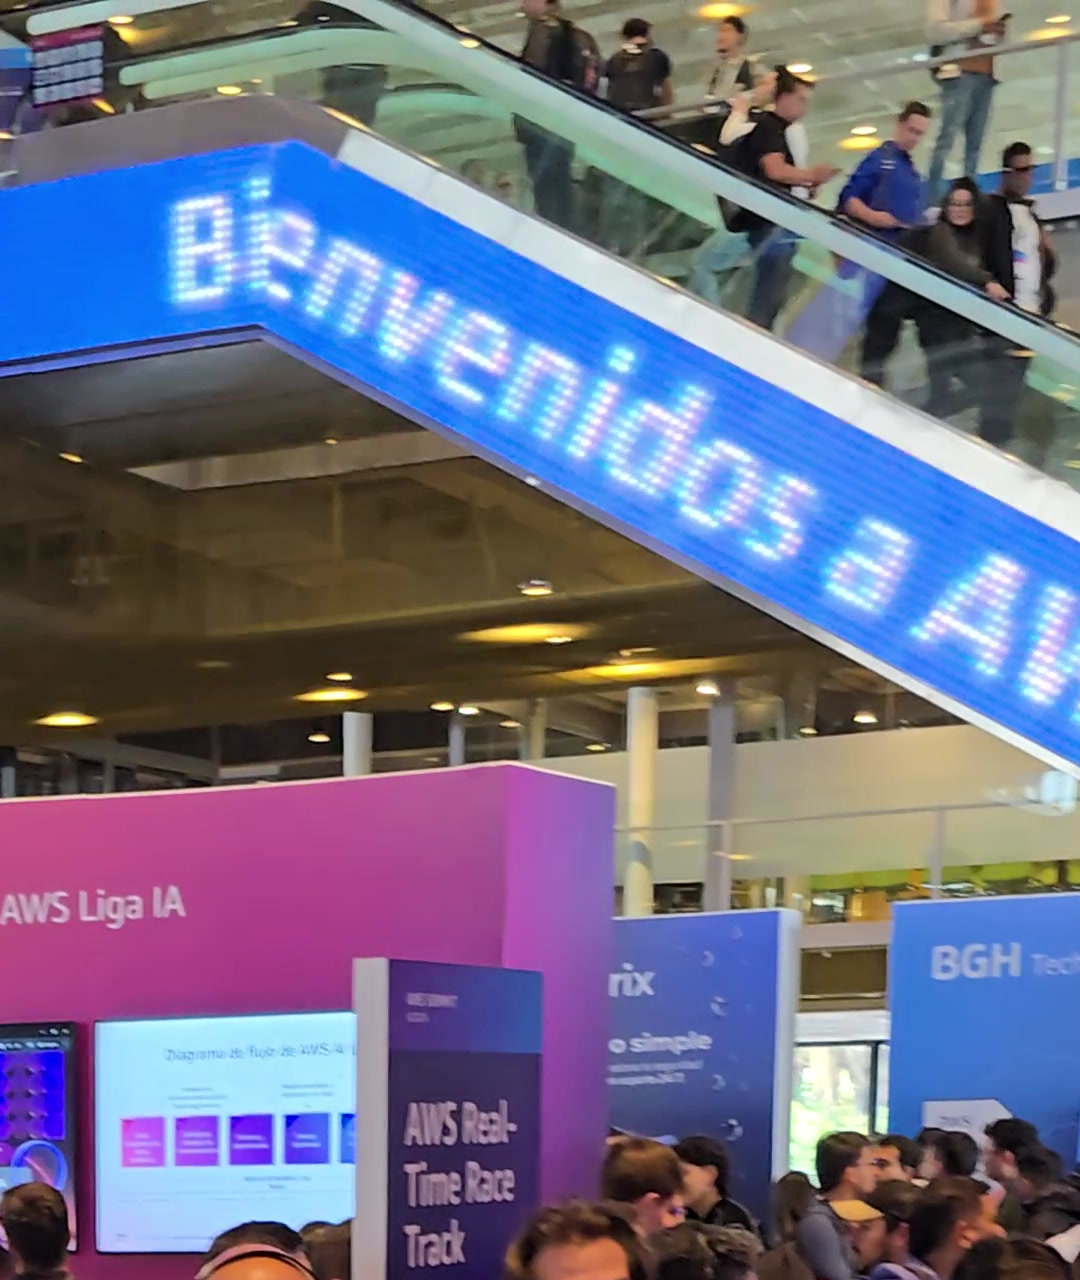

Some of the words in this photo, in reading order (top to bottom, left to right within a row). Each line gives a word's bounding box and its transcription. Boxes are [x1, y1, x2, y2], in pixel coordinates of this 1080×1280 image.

[170, 175, 817, 562] Bienvenidos
[828, 520, 912, 613] a
[79, 888, 144, 930] Liga
[152, 884, 187, 918] IA
[931, 942, 1022, 981] BGH
[629, 1030, 713, 1056] simple
[403, 1100, 458, 1146] AWS
[461, 1098, 518, 1145] Real-
[402, 1161, 461, 1208] Time
[464, 1160, 517, 1204] Race
[402, 1218, 466, 1268] Track
